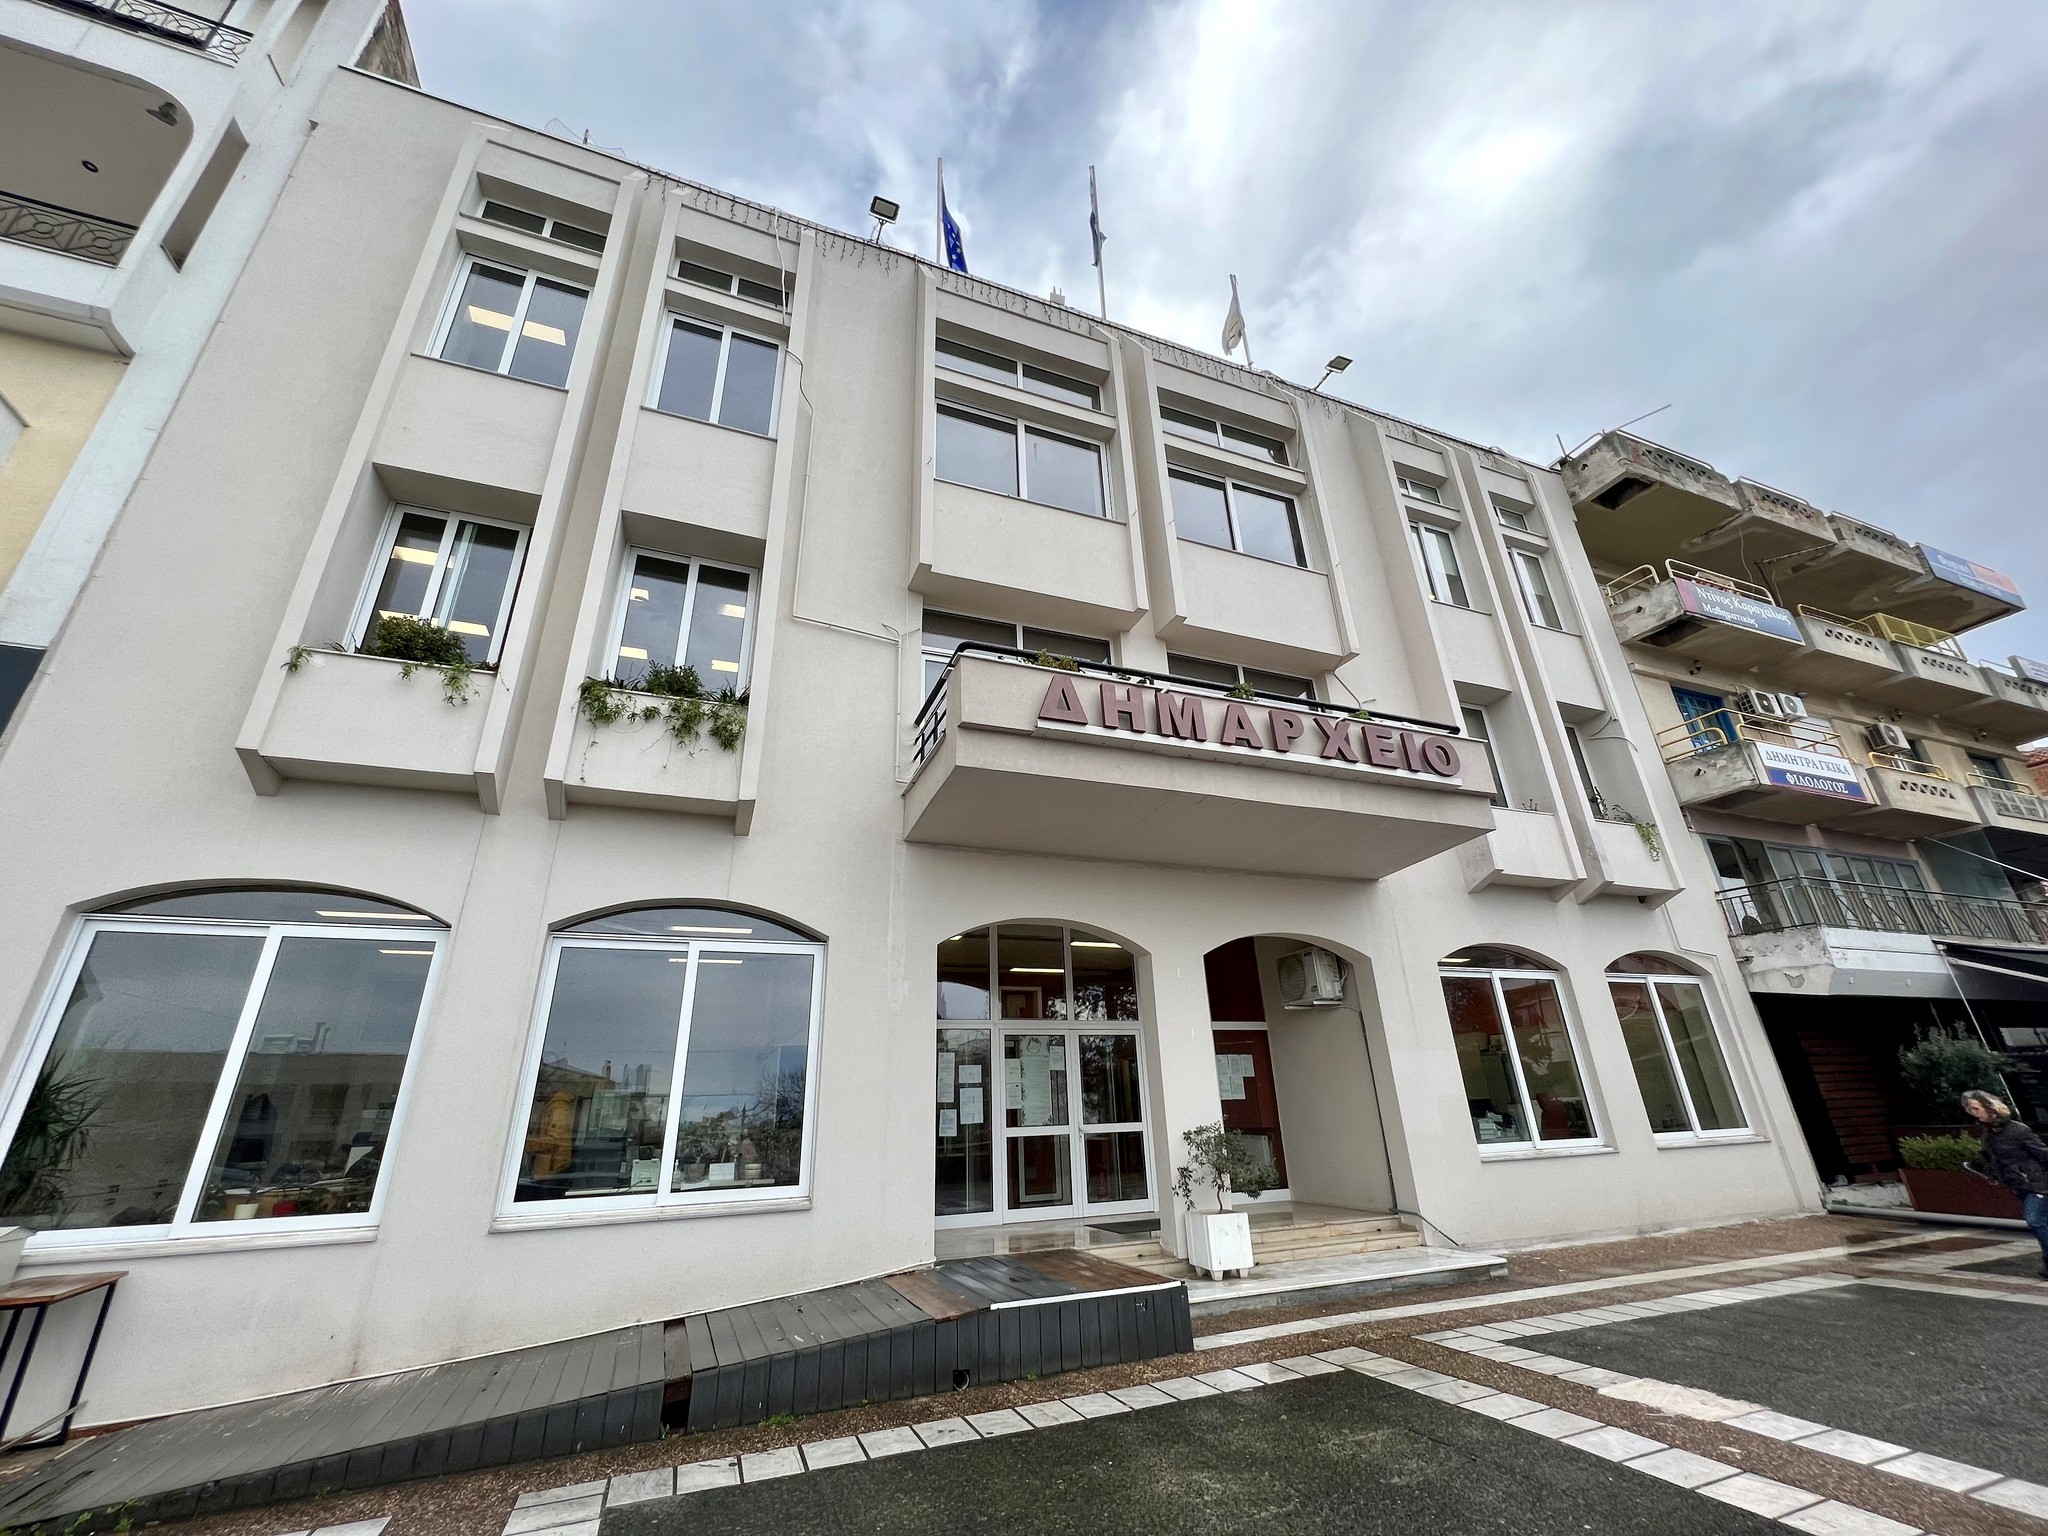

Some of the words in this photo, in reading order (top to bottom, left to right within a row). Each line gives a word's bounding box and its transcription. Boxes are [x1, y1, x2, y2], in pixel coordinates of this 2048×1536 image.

[1696, 586, 1734, 609] Ντίνος
[1732, 596, 1791, 625] Καραχάλιος
[1038, 674, 1462, 777] ΔΗΜΑΡΧΕΙΟ
[1766, 750, 1818, 769] ΔΗΜΗΤΡΑ
[1817, 759, 1851, 775] ΓΚΙΚΑ
[1785, 772, 1849, 794] ΦΙΛΟΛΟΓΟΣ
